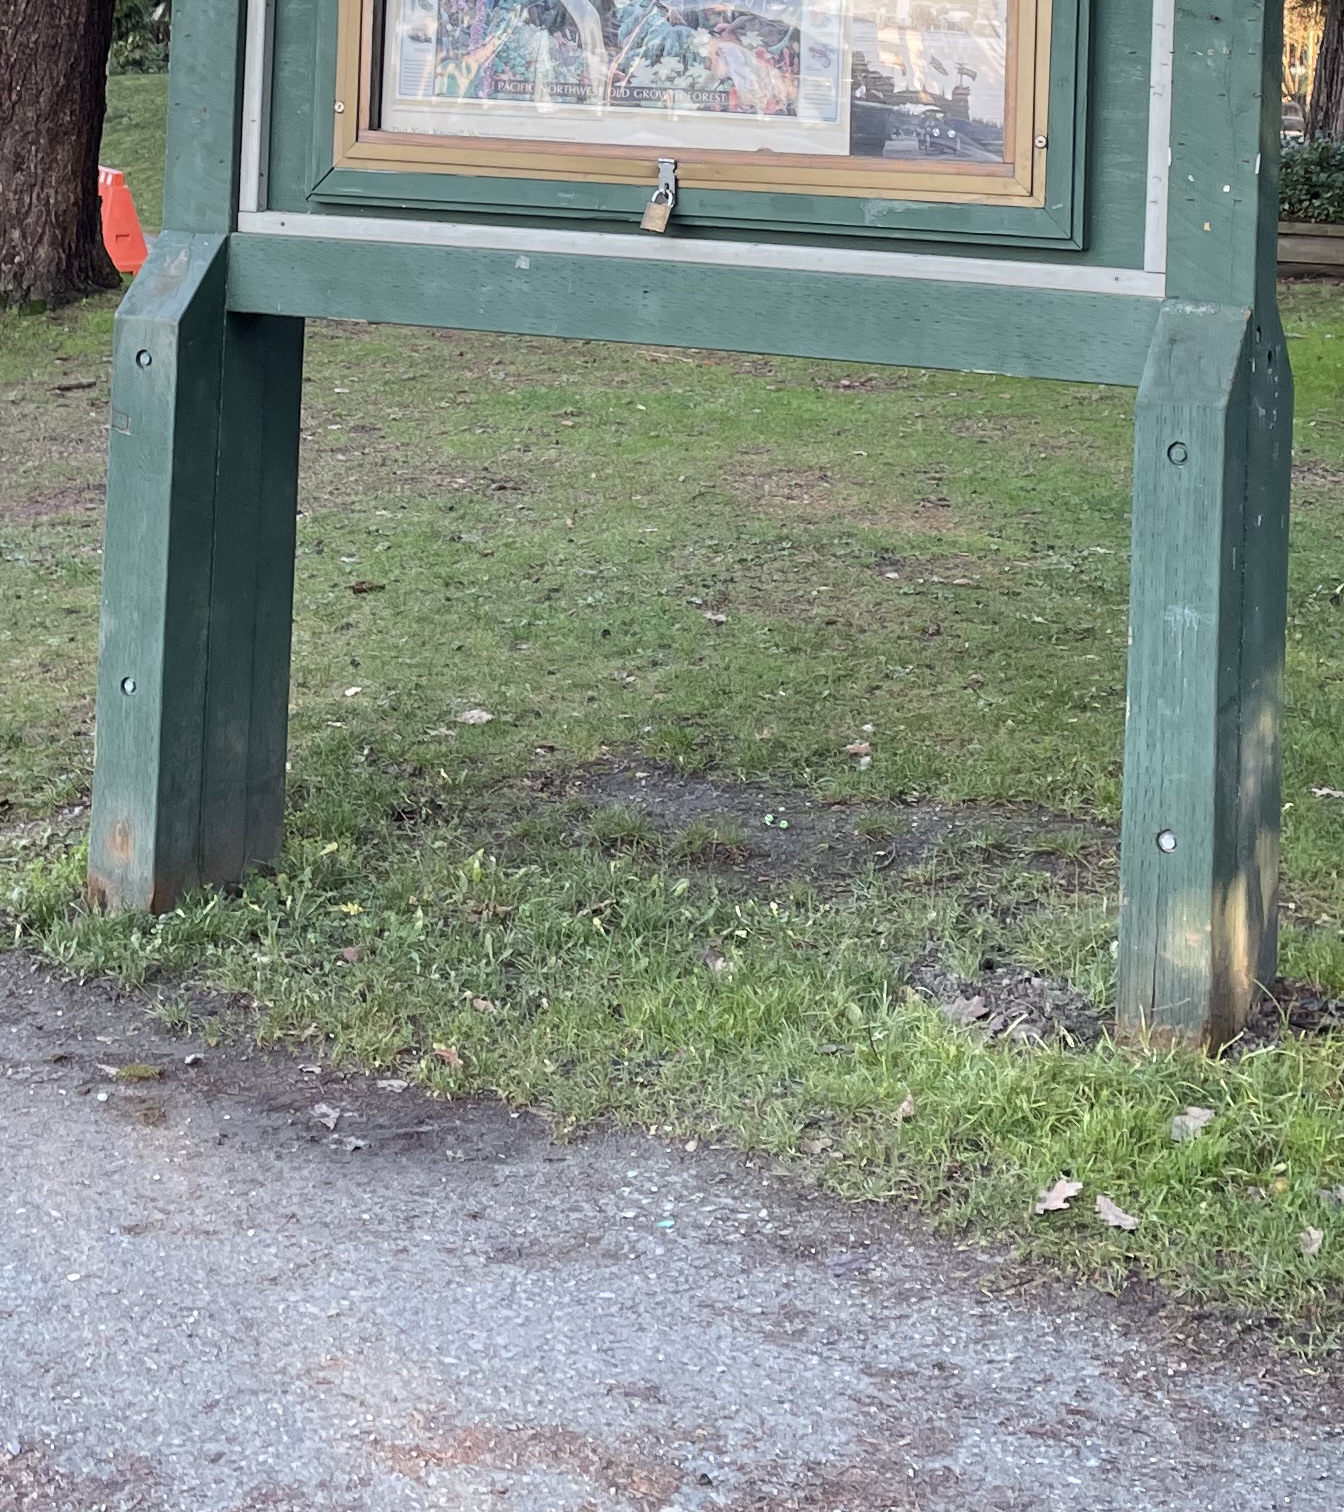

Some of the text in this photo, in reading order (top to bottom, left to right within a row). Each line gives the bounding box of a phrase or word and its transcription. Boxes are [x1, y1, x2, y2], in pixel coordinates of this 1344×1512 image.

[497, 81, 535, 93] PACIFIC
[609, 87, 630, 99] OLD
[633, 88, 685, 102] GROW
[687, 91, 727, 104] FOREST
